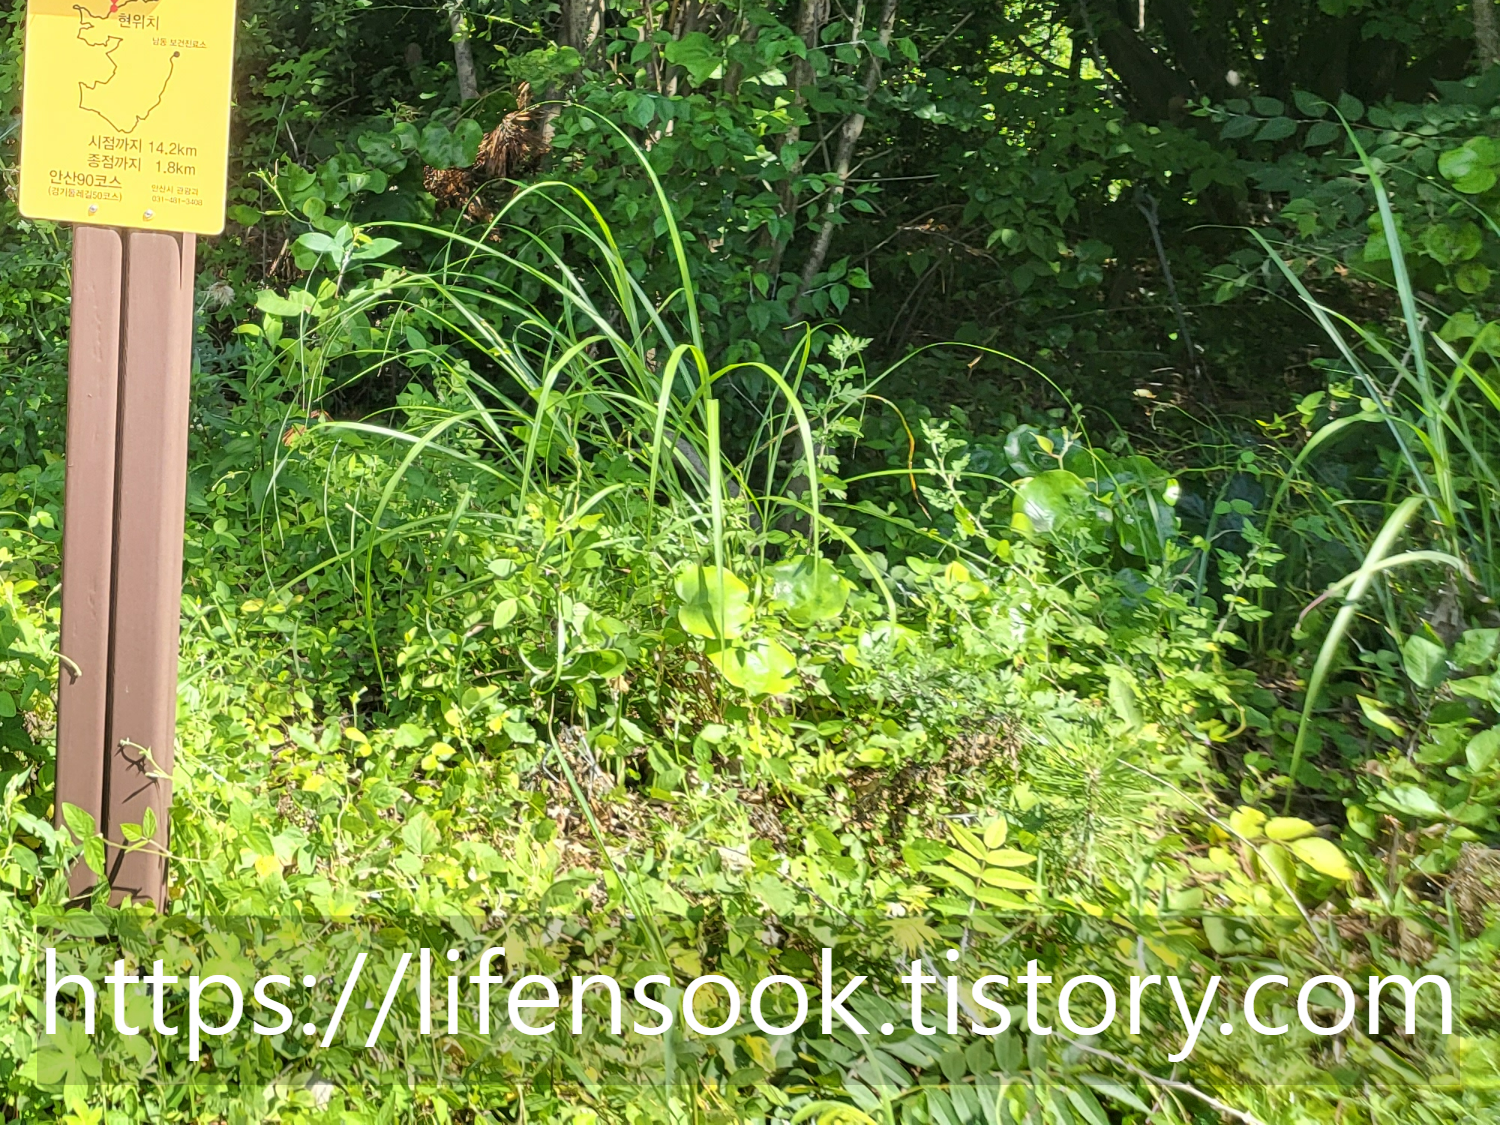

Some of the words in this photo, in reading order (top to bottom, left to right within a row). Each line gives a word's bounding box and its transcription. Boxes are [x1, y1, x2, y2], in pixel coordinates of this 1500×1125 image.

[118, 13, 160, 31] 현위치
[88, 134, 142, 153] 시점까지
[148, 140, 198, 158] 14.2km
[86, 153, 142, 172] 종점까지
[155, 159, 196, 176] 1.8km
[49, 169, 122, 189] 안산90코스
[48, 186, 122, 203] (경기둘레길50코스)
[152, 184, 174, 195] 안산시
